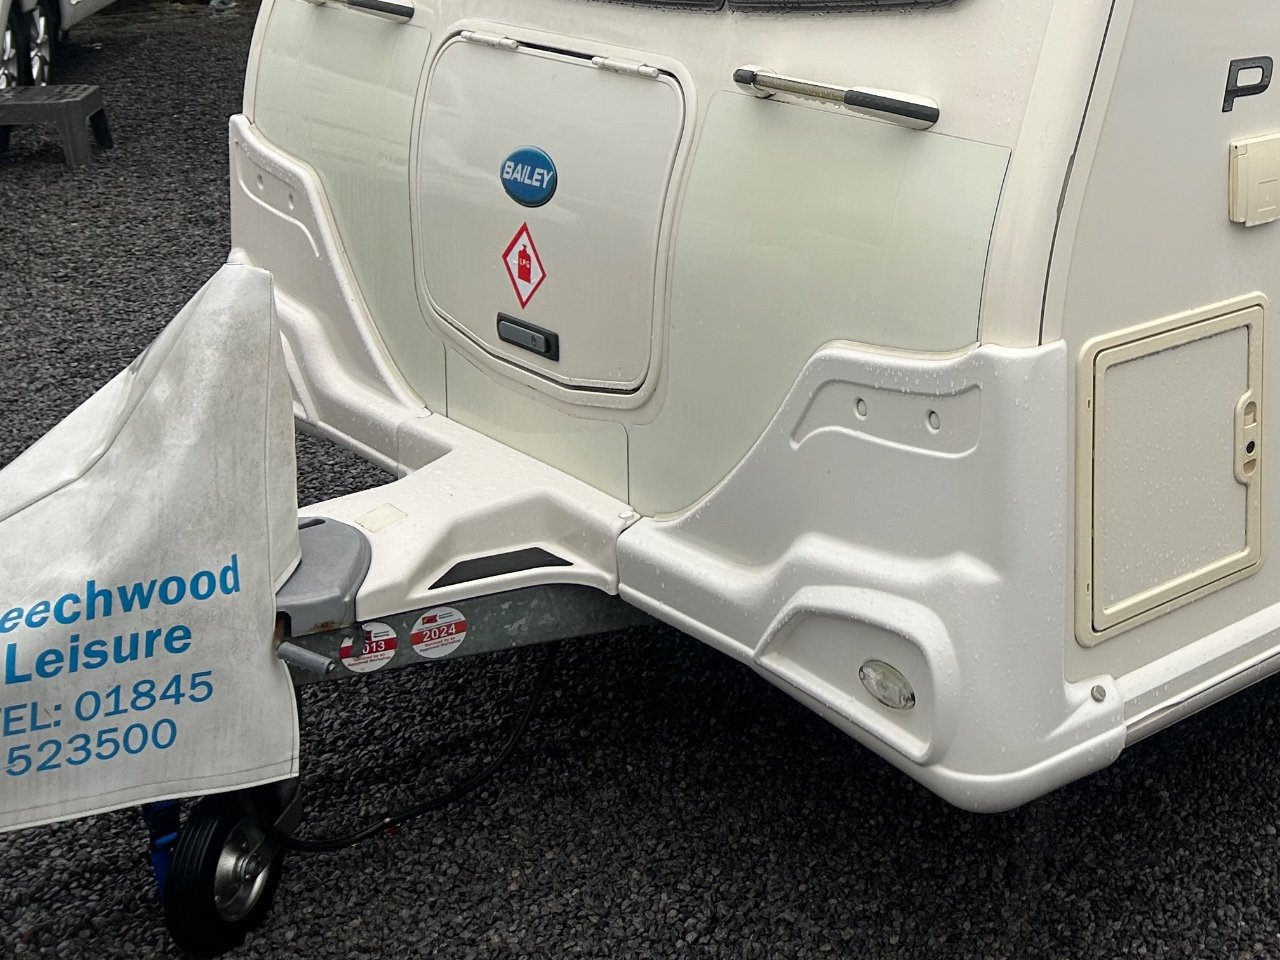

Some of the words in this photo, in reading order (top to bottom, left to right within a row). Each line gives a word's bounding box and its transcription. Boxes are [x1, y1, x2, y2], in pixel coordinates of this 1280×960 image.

[501, 160, 553, 189] BAILEY
[0, 553, 241, 633] eechwood
[4, 623, 192, 685] Leisure
[362, 640, 386, 654] 013
[422, 623, 457, 642] 2024
[0, 701, 62, 737] EL:
[74, 670, 214, 722] 01845
[5, 717, 178, 777] 523500
